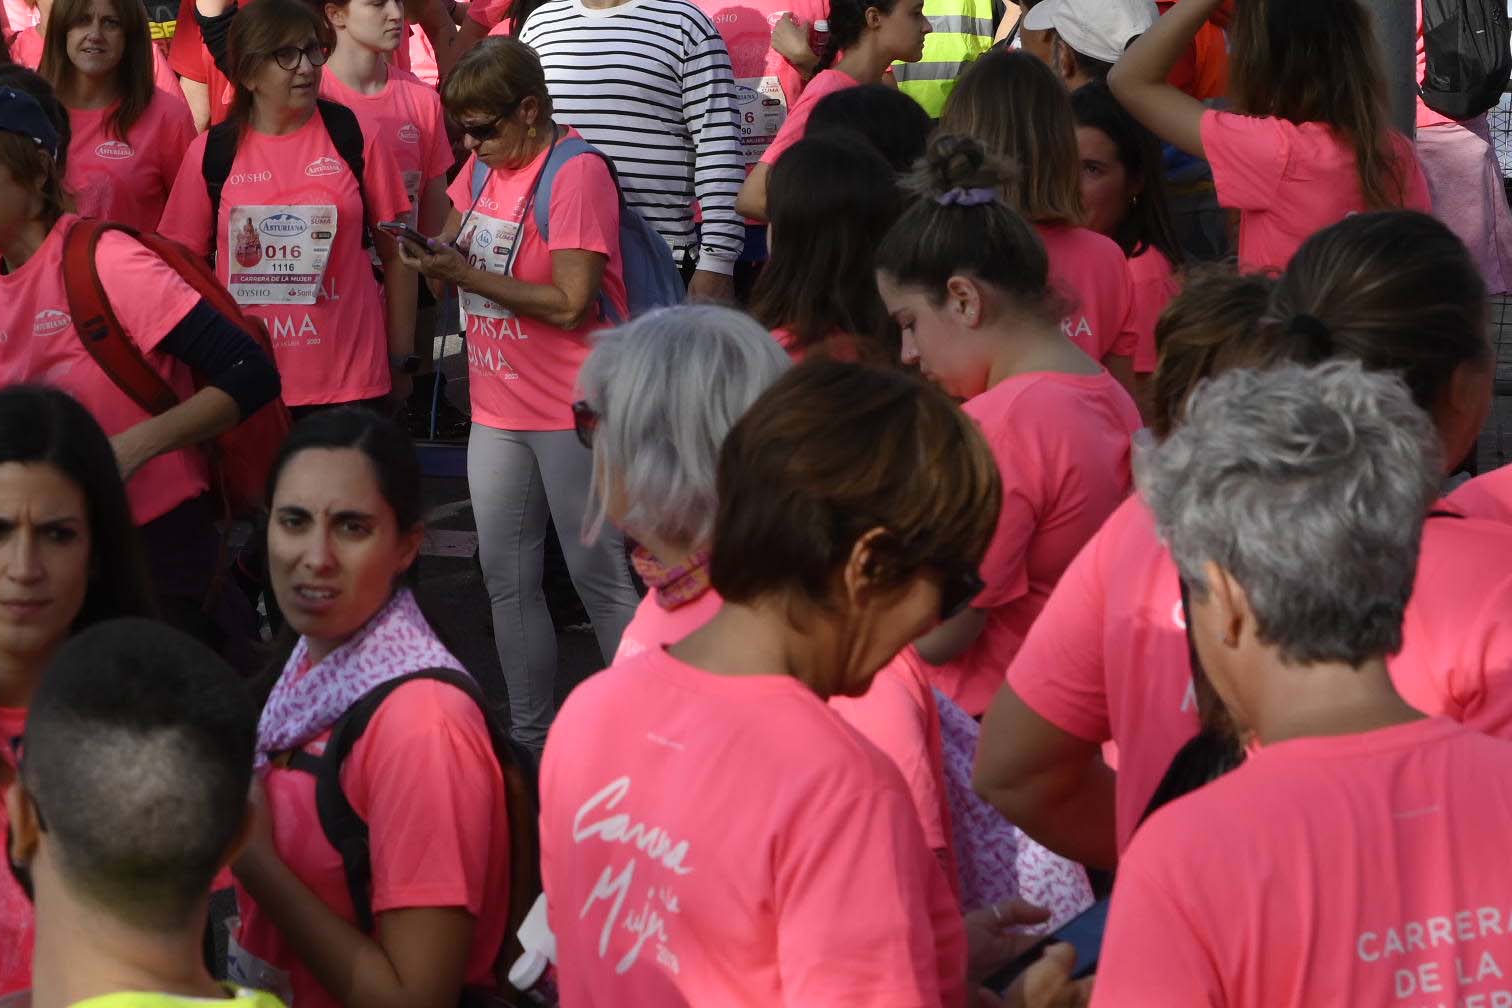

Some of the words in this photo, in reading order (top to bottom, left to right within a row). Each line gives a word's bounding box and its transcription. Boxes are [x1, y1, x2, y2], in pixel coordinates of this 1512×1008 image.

[231, 170, 272, 185] OYSHO
[263, 222, 304, 233] ASTURIANA
[265, 245, 302, 259] 016
[271, 263, 295, 272] 1116
[236, 289, 271, 298] OYSHO
[1356, 906, 1512, 963] CARRER
[1394, 961, 1445, 999] DE
[1454, 950, 1505, 985] LA
